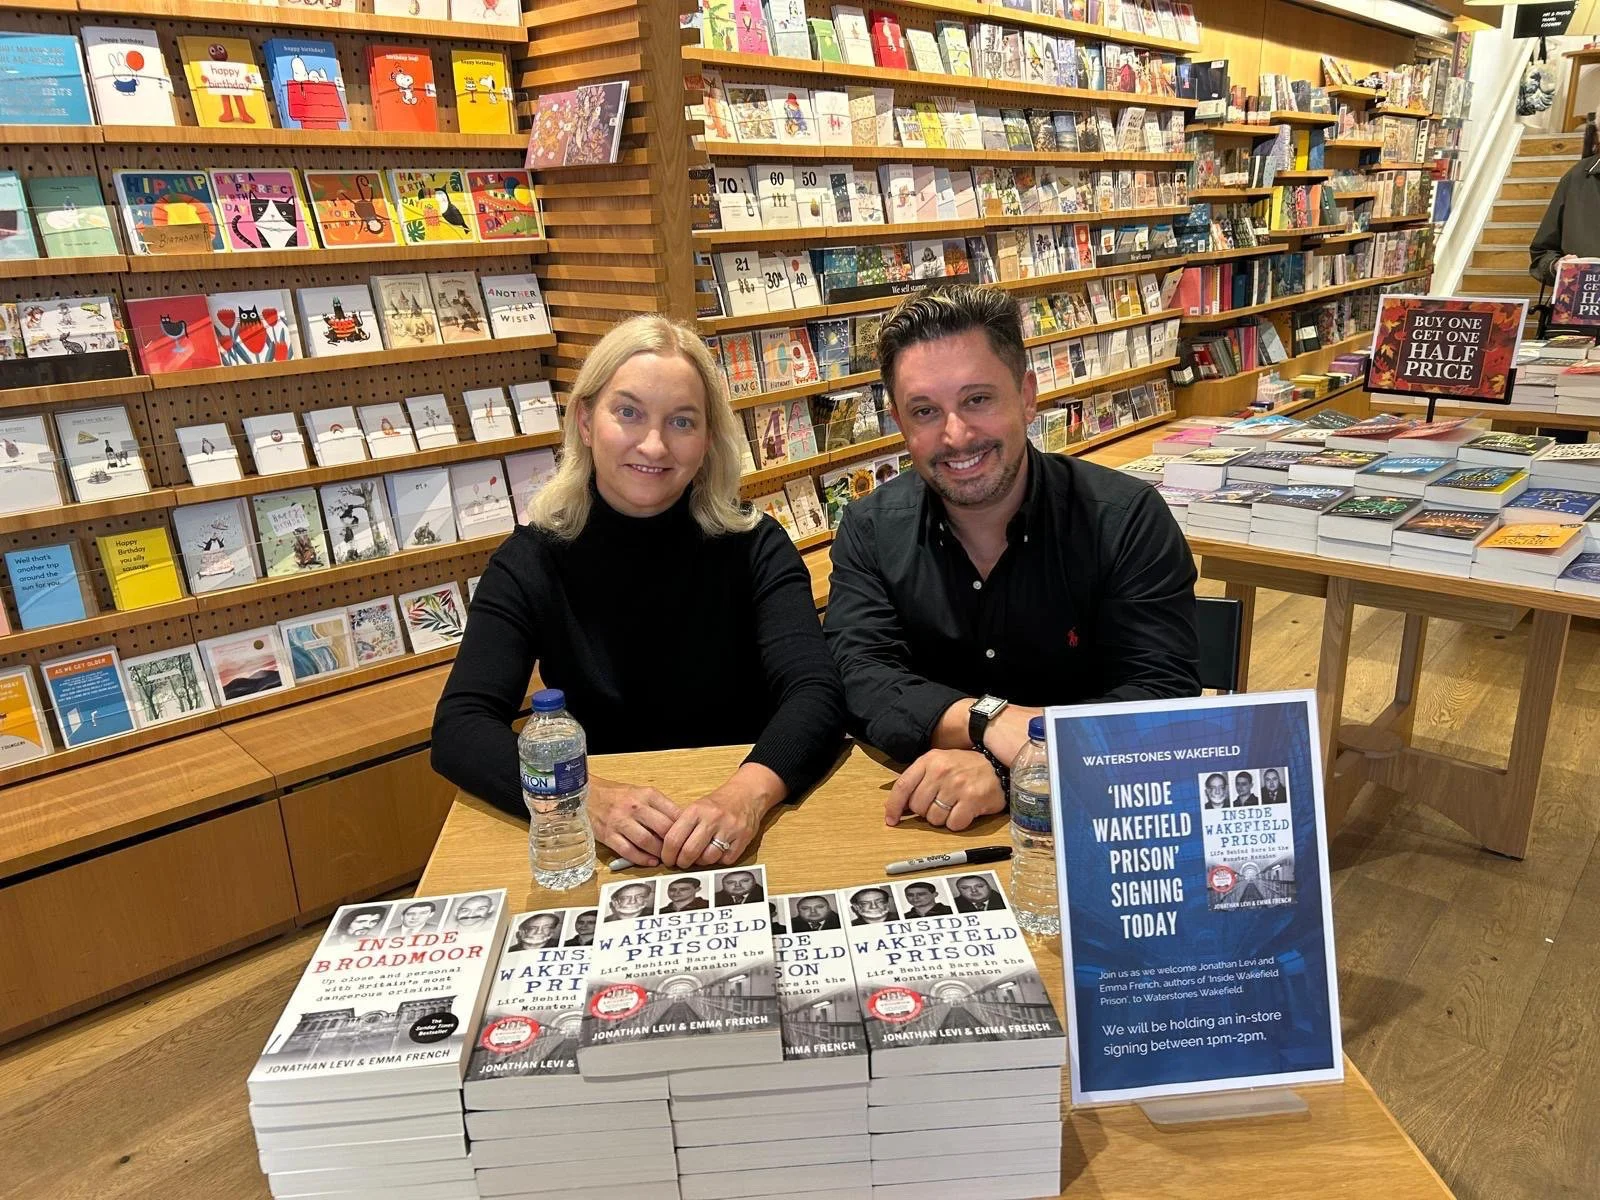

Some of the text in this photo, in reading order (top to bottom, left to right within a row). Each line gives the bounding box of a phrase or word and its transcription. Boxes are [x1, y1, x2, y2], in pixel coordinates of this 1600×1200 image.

[211, 65, 240, 77] happy
[208, 80, 250, 90] birthday
[719, 178, 738, 193] 70
[770, 172, 784, 185] 60
[802, 172, 816, 186] 50
[236, 184, 293, 194] PURRFECT
[736, 257, 750, 271] 21
[796, 272, 808, 287] 40
[488, 288, 536, 298] ANOTHER
[508, 302, 534, 312] YEAR
[500, 314, 536, 322] WISER
[1414, 316, 1482, 330] BUY ONE
[1412, 330, 1480, 344] GET ONE
[1408, 342, 1478, 362] HALF
[1404, 360, 1474, 380] PRICE
[763, 410, 786, 459] 4
[31, 554, 52, 562] that's
[118, 546, 146, 556] Birthday
[17, 562, 59, 573] another trip
[122, 564, 148, 572] sausage
[20, 574, 45, 582] around
[1083, 745, 1240, 766] WATERSTONES WAKEFIELD
[1108, 782, 1172, 809] 'INSIDE
[1221, 808, 1272, 822] INSIDE
[1093, 812, 1192, 842] WAKEFIELD
[1205, 819, 1290, 836] WAKEFIELD
[1221, 834, 1276, 848] PRISON
[1110, 846, 1180, 874] PRISON'
[1111, 878, 1184, 908] SIGNING
[636, 908, 732, 931] INSIDE
[886, 914, 980, 936] INSIDE
[1120, 911, 1178, 939] TODAY
[354, 931, 459, 952] INSIDE
[600, 918, 766, 951] WAKEFIELD
[773, 935, 811, 948] DE
[856, 927, 1018, 954] WAKEFIELD
[537, 949, 592, 963] INS
[627, 936, 739, 962] PRISON
[887, 944, 996, 965] PRISON
[312, 946, 484, 974] BROADMOOR
[601, 965, 628, 976] Life
[635, 959, 679, 970] Behind
[686, 955, 717, 964] Bars
[743, 950, 764, 958] the
[866, 970, 895, 978] Life
[900, 964, 943, 974] Behind
[950, 960, 980, 968] Bars
[1004, 956, 1024, 964] the
[1099, 971, 1116, 980] Join
[1142, 968, 1155, 976] we
[1157, 964, 1196, 974] welcome
[1198, 960, 1237, 971] Jonathan
[1239, 958, 1256, 967] Levi
[1258, 956, 1274, 966] and
[321, 967, 462, 986] Up close and personal
[625, 962, 737, 980] Monster Mansion
[894, 968, 1002, 982] Monster Mansion
[325, 976, 452, 993] with Britain's most
[524, 978, 582, 994] PRI
[1100, 982, 1128, 992] Emma
[1163, 976, 1195, 987] authors
[1197, 975, 1206, 984] of
[1236, 969, 1279, 980] Wakefield
[316, 985, 452, 1002] dangerous criminals
[498, 998, 524, 1006] Life
[1133, 994, 1142, 1003] to
[1144, 989, 1198, 1002] Waterstones
[1200, 984, 1244, 996] Wakefield.
[521, 1004, 574, 1012] Monster
[415, 1024, 440, 1032] Sunday
[592, 1015, 768, 1041] JONATHAN LEVI & EMMA FRENCH
[1102, 1010, 1282, 1036] We will be holding an in-store
[418, 1028, 448, 1036] Bestseller
[882, 1022, 1051, 1042] JONATHAN LEVI & EMMA FRENCH
[783, 1041, 856, 1055] MMA FRENCH
[1104, 1030, 1267, 1058] signing between 1pm-2pm.
[266, 1048, 451, 1074] JONATHAN LEVI & EMMA FRENCH
[480, 1060, 575, 1074] JONATHAN LEVI &
